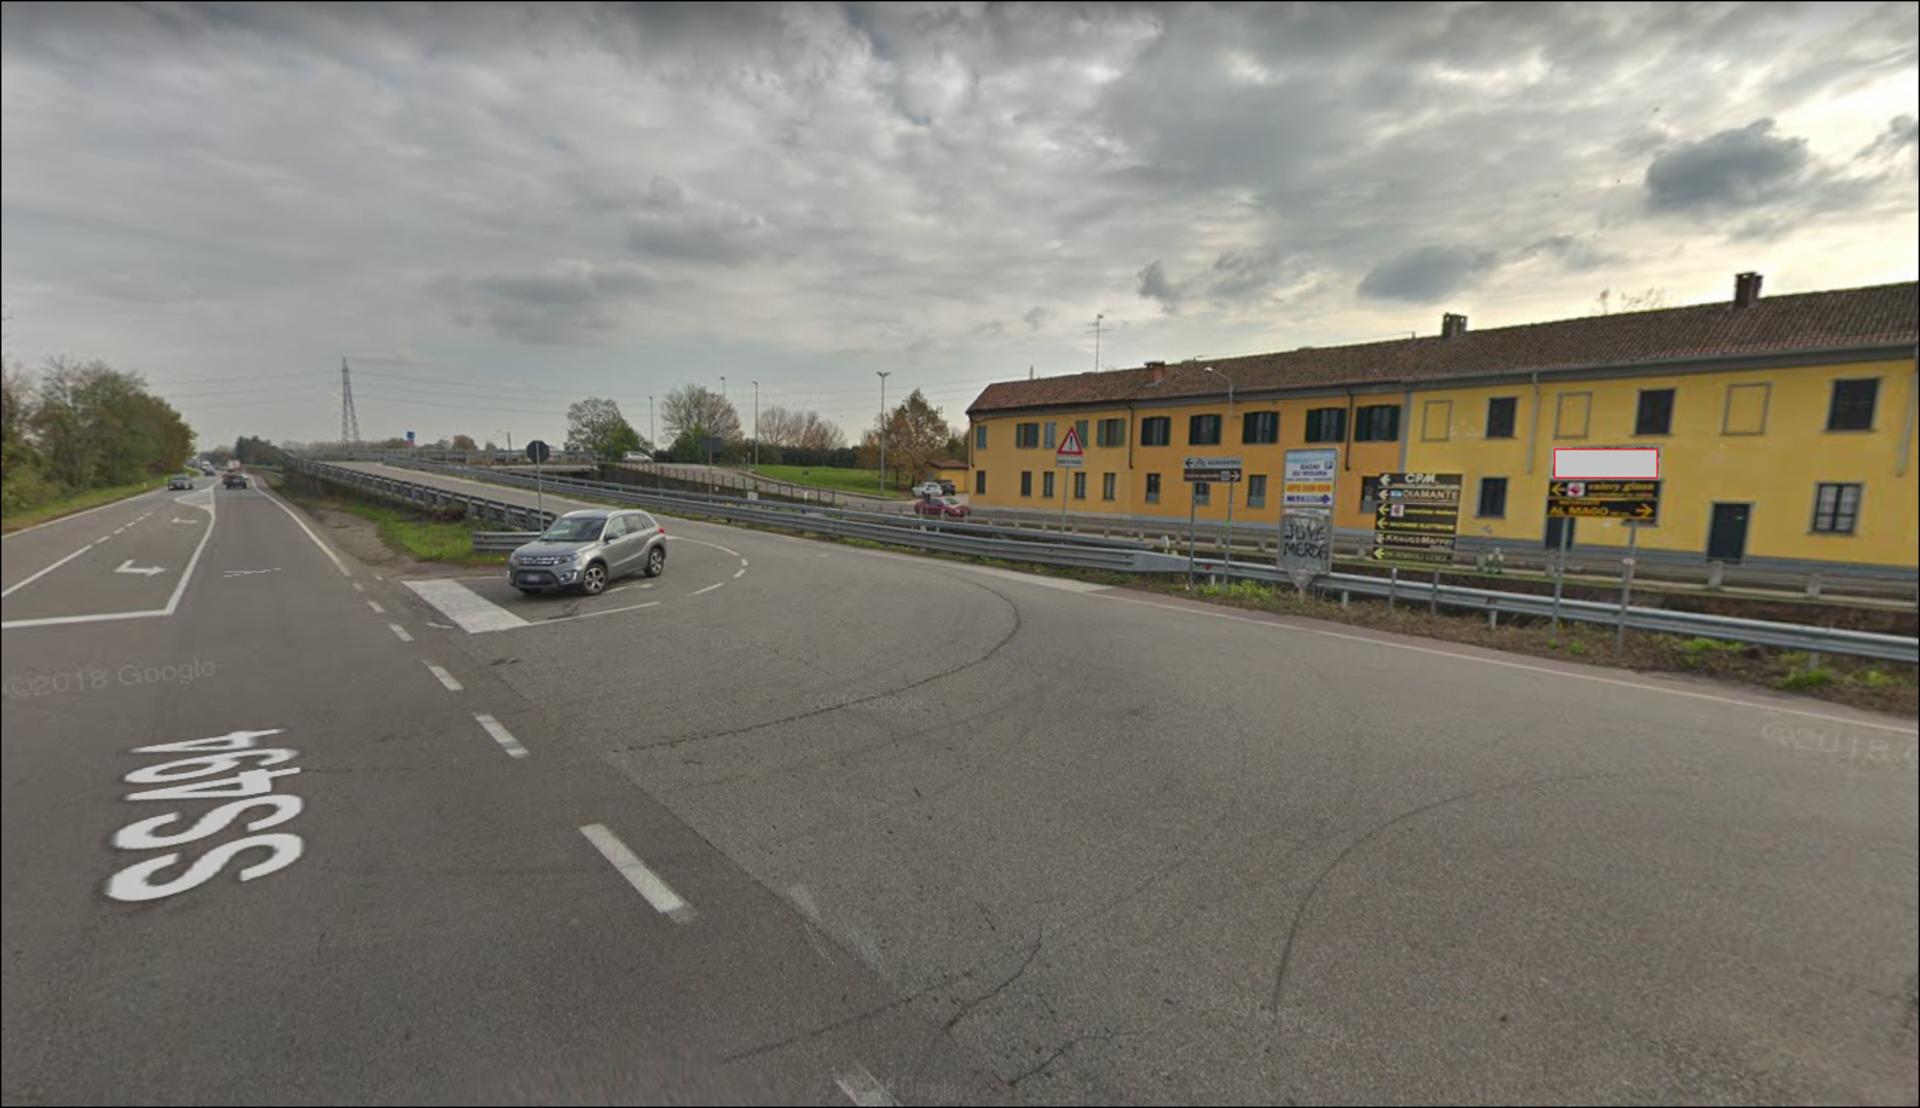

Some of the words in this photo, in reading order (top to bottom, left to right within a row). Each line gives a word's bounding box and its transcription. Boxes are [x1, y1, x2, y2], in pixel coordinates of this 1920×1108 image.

[1403, 489, 1458, 500] DIAMANTE
[1283, 523, 1327, 542] JUVE
[1283, 542, 1329, 561] MERDA
[103, 729, 304, 902] SS494
